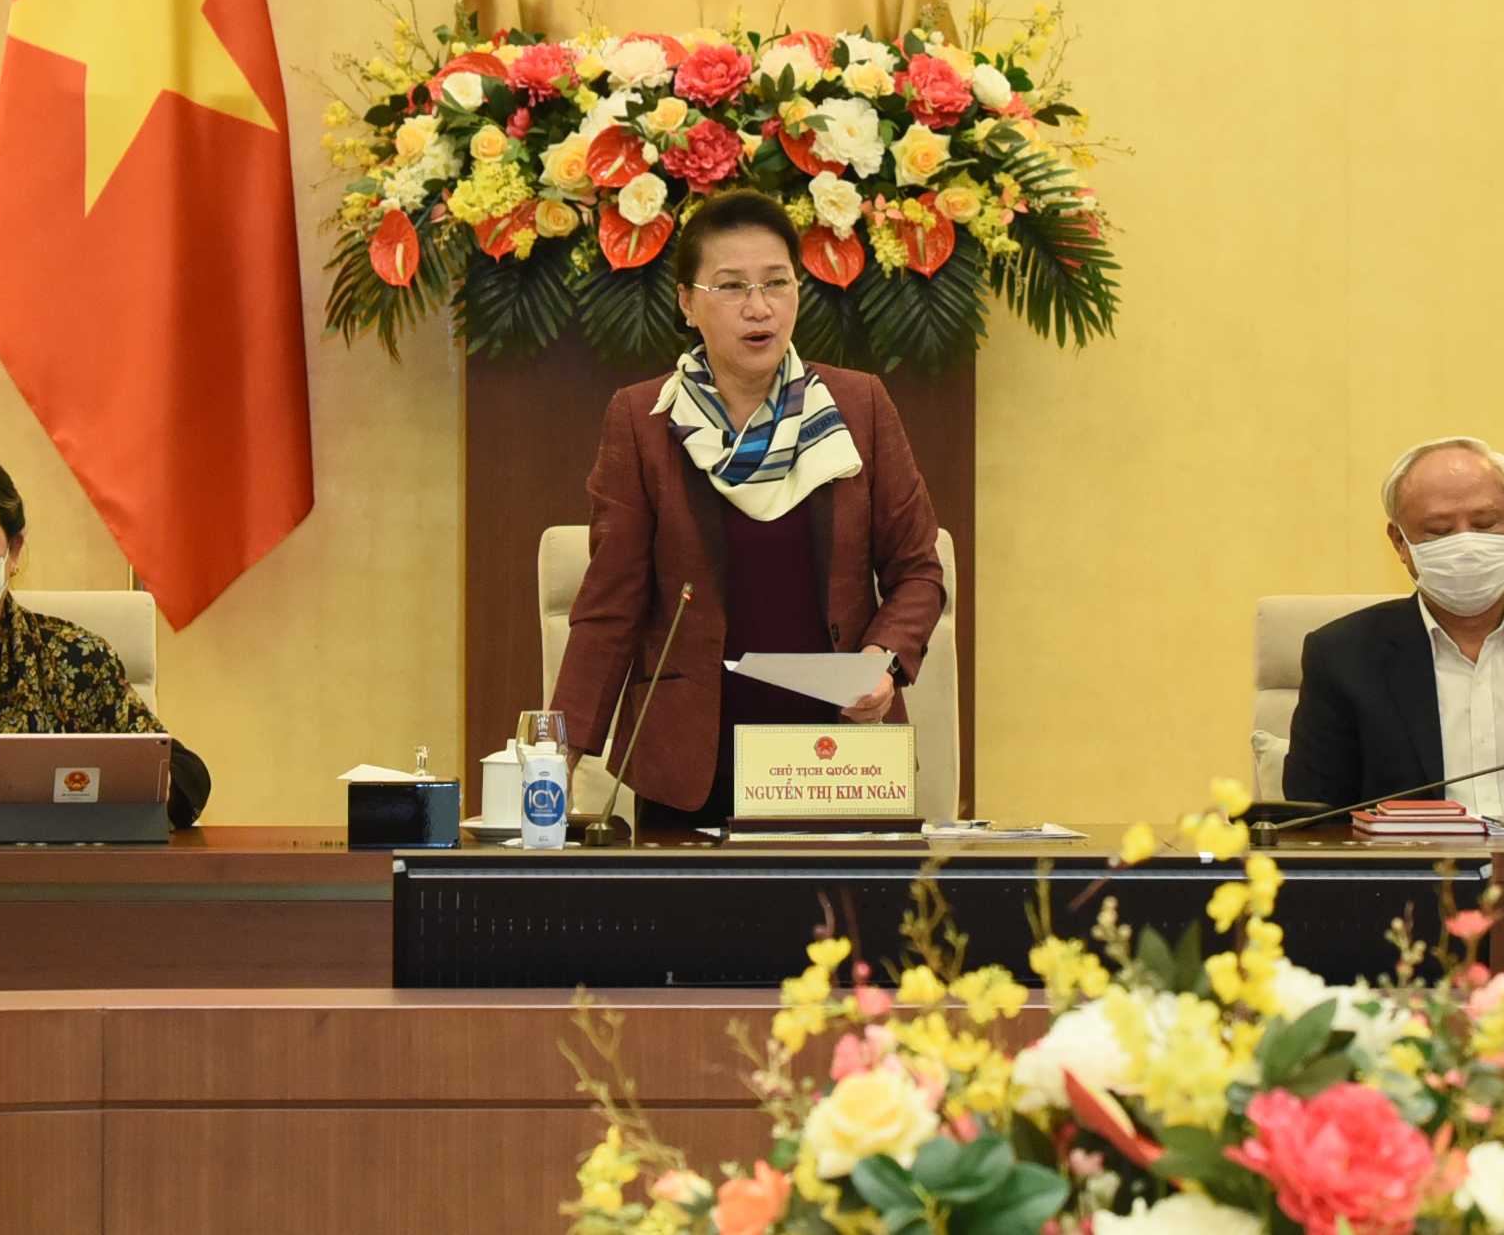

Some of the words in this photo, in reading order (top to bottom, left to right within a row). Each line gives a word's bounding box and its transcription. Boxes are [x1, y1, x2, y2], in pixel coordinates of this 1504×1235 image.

[769, 764, 793, 776] CHỦ
[796, 767, 823, 778] TỊCH
[826, 764, 858, 776] QUỐC
[860, 765, 882, 777] HỘI
[528, 789, 561, 809] ICY
[745, 778, 804, 800] NGUYỄN
[807, 785, 833, 803] THỊ
[835, 785, 864, 800] KIM
[866, 781, 907, 800] NGÂN
